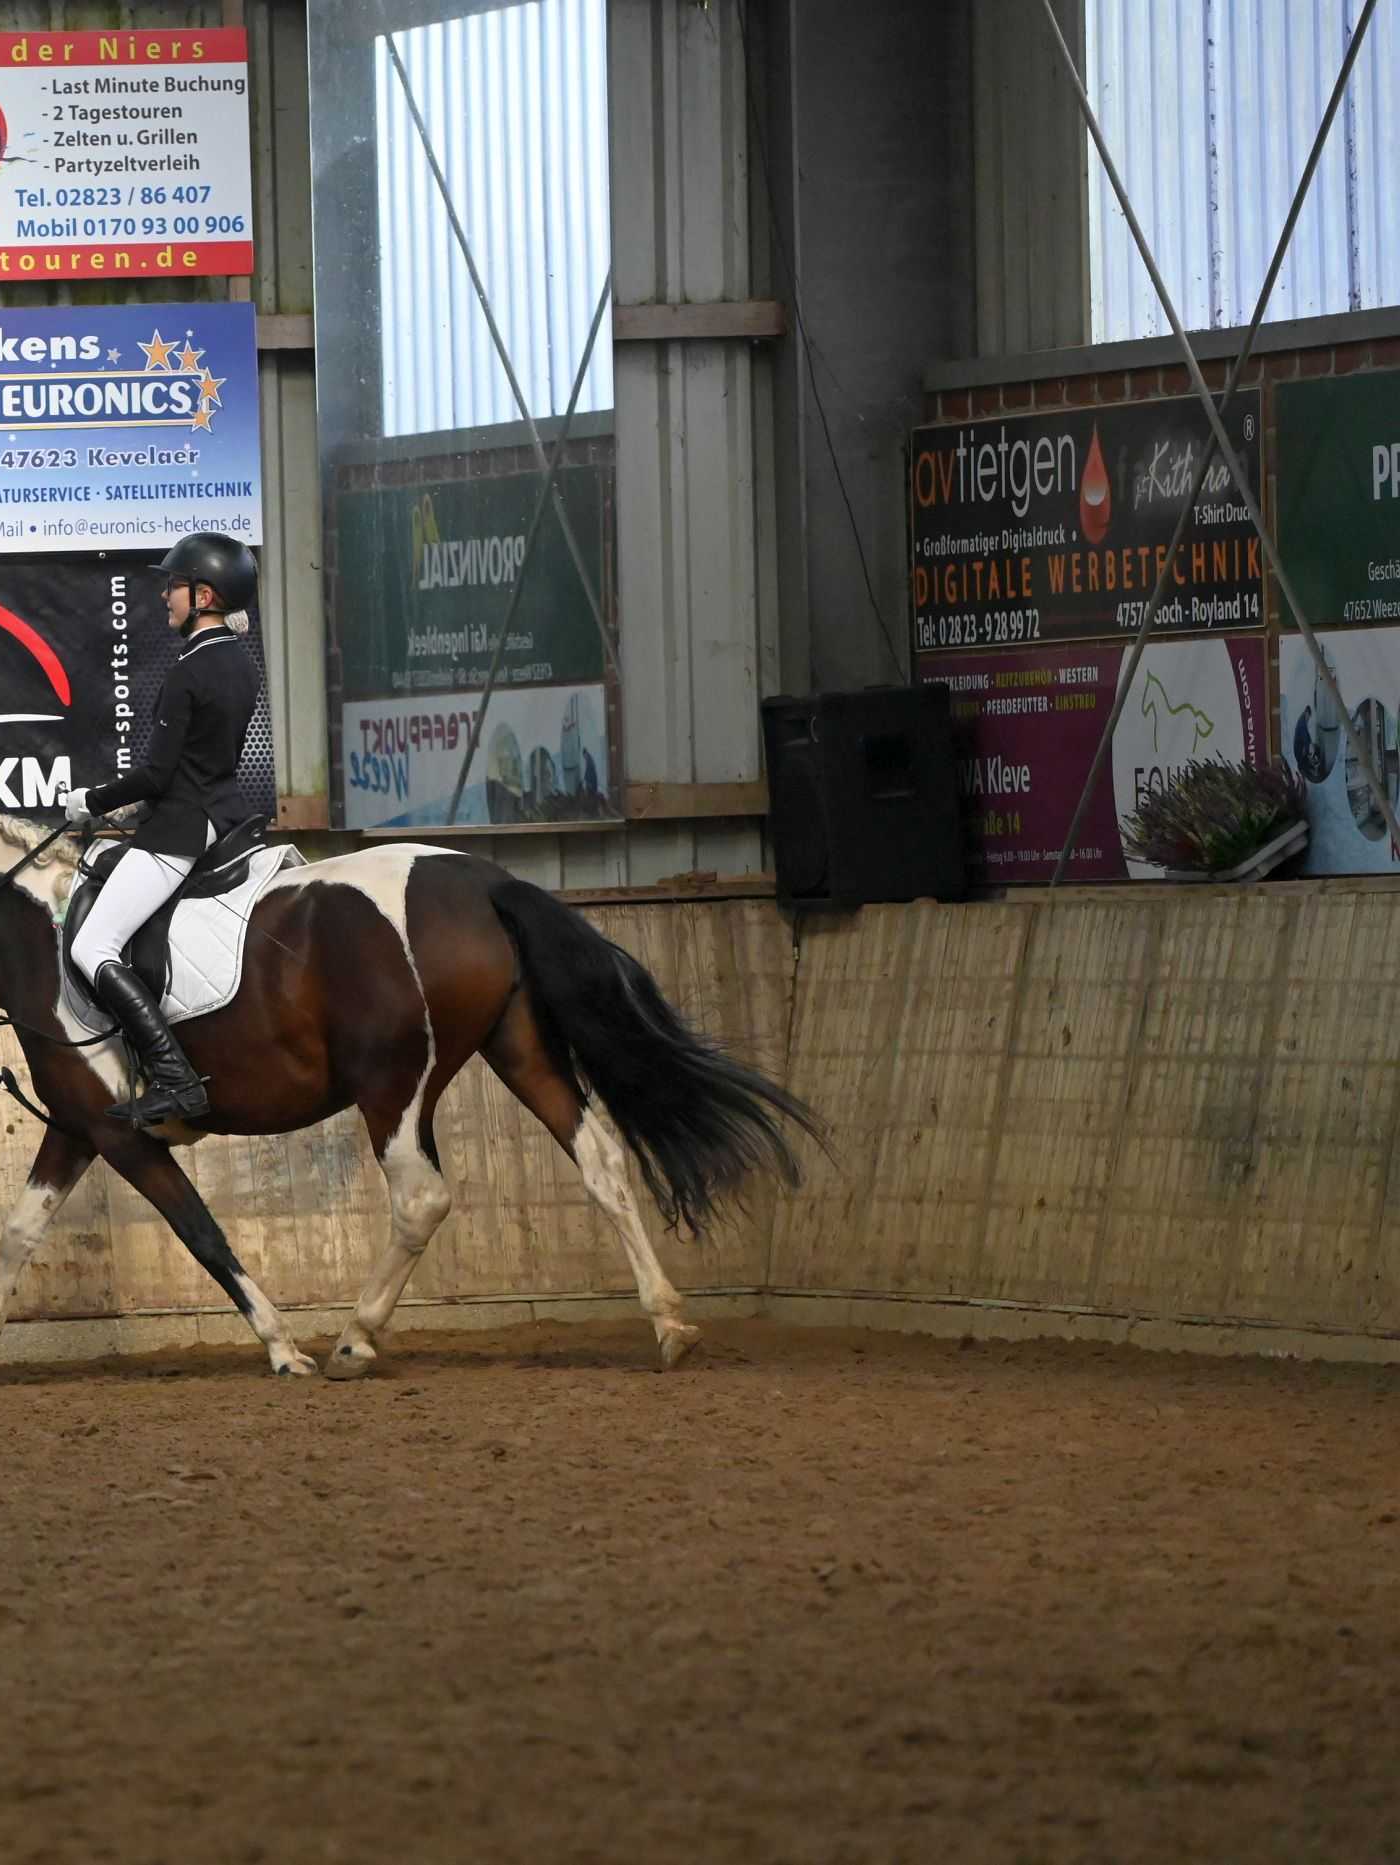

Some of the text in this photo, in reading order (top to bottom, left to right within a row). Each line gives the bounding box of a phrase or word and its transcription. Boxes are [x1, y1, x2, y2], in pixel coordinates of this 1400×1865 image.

[11, 38, 74, 61] der
[100, 37, 205, 60] Niers
[52, 76, 246, 95] Last Minute Buchung
[53, 105, 183, 124] 2 Tagestouren
[54, 130, 198, 147] Zelten u. Grillen
[55, 156, 200, 176] Partyzeltverleih
[15, 188, 51, 207] Tel.
[56, 187, 121, 207] 02823
[141, 187, 166, 205] 86
[172, 186, 212, 204] 407
[17, 215, 244, 238] Mobil 0170 93 00 906
[1, 381, 194, 418] EURONICS
[0, 449, 78, 469] 47623
[88, 445, 200, 468] Kevelaer
[916, 425, 1075, 517] avtietgen
[106, 481, 253, 500] SATELLITENTECHNIK
[43, 514, 250, 537] info@euronics-heckens.de
[1194, 502, 1252, 526] T-Shirt Druc
[923, 524, 1066, 557] Großformatiger Digitaldruck
[916, 538, 1262, 607] DIGITALE WERBETECHNIK
[917, 617, 936, 646] Tel:
[1192, 596, 1240, 626] Royland
[1244, 593, 1259, 618] 14
[111, 576, 134, 779] m-sports.com
[1058, 666, 1098, 684] WESTERN
[986, 697, 1048, 716] PFERDEFUTTER
[987, 755, 1031, 794] Kleve
